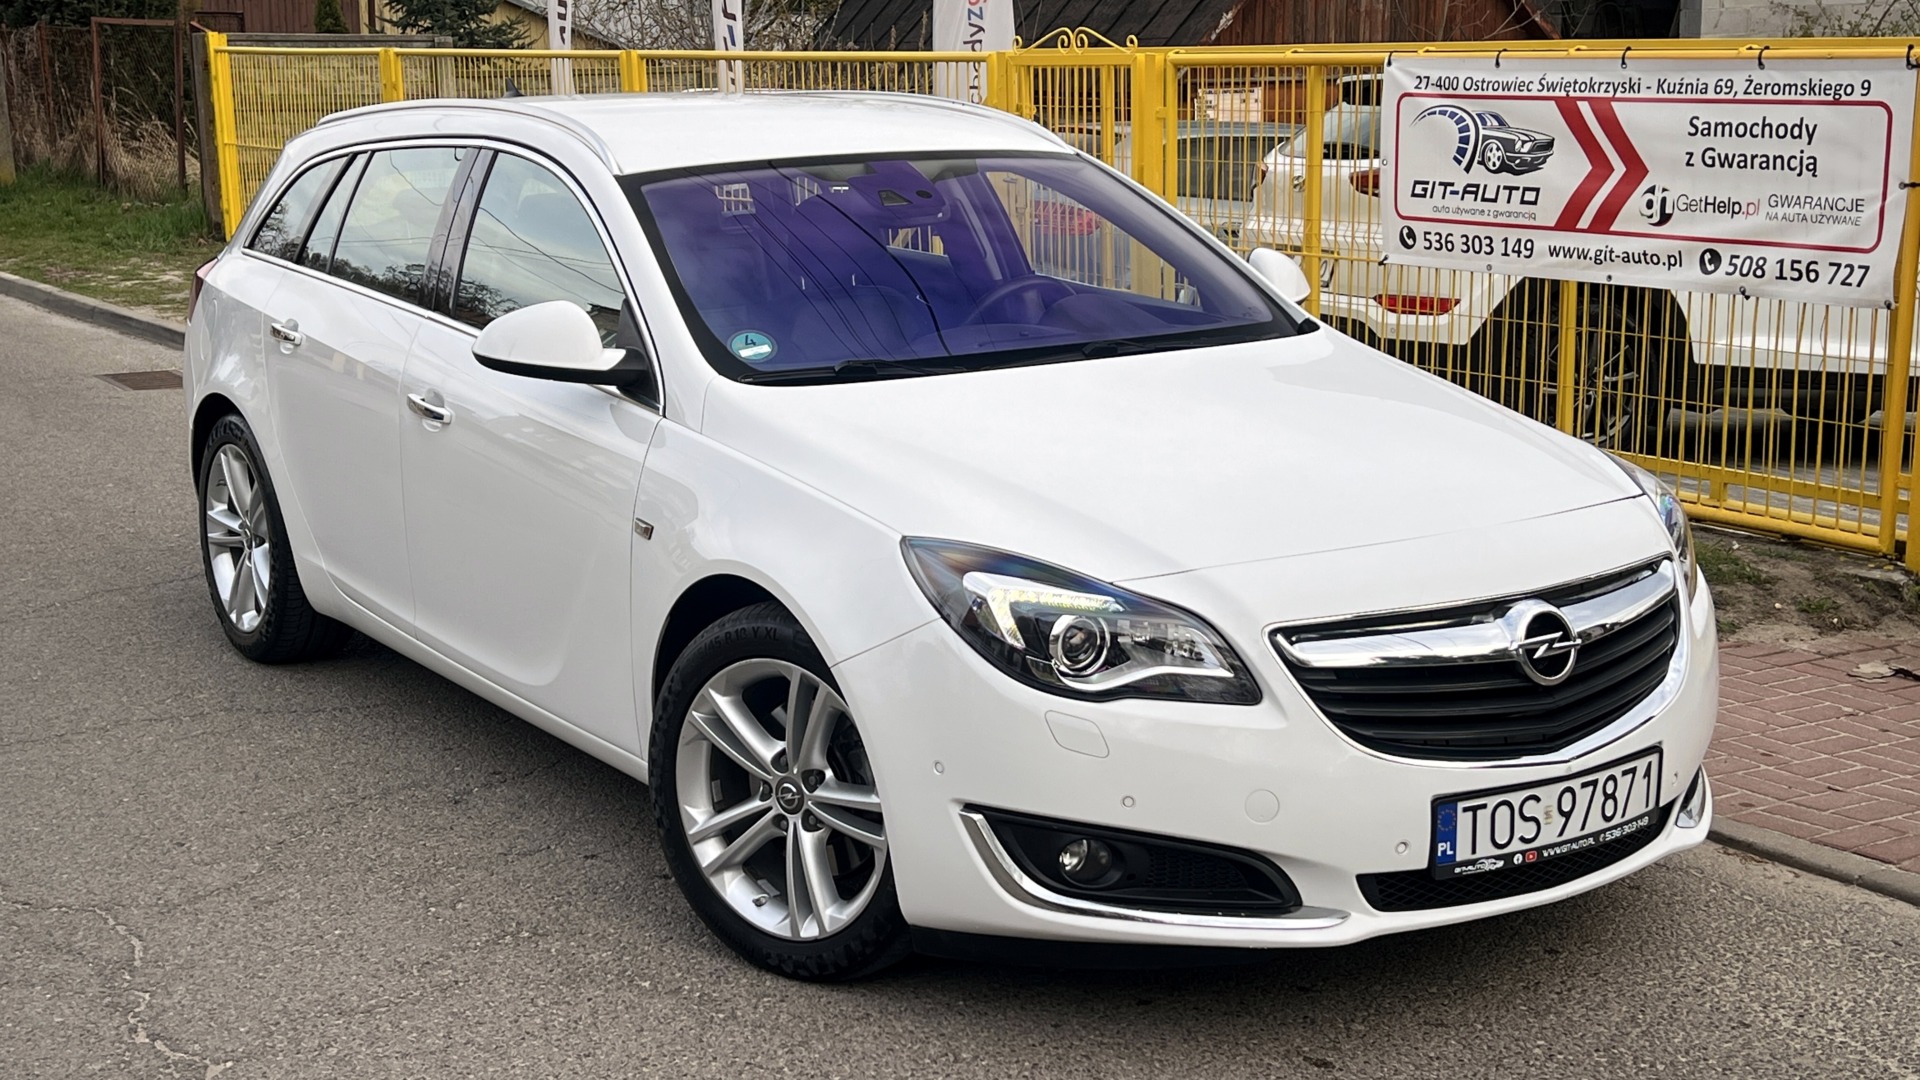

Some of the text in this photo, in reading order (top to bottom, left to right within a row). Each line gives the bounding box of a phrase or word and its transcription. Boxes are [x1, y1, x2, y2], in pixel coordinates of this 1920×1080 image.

[1413, 75, 1459, 91] 27-400
[1463, 77, 1534, 93] Ostrowiec
[1537, 73, 1641, 97] Świętokrzyski
[1656, 77, 1708, 95] Kuźnia
[1714, 78, 1738, 98] 69,
[1743, 74, 1855, 100] Żeromskiego
[1860, 79, 1872, 97] 9
[1687, 115, 1818, 146] Samochody
[1685, 147, 1818, 178] z Gwarancją
[1410, 180, 1541, 206] GIT-AUTO
[1768, 194, 1865, 213] GWARANCJE
[1432, 205, 1450, 213] auta
[1676, 194, 1760, 219] GetHelp.pl
[1765, 211, 1779, 221] NA
[1780, 213, 1808, 223] AUTA
[1423, 231, 1534, 259] 536 303 149
[1548, 244, 1683, 271] www.git-auto.pl
[1725, 254, 1871, 288] 508 156 727
[744, 334, 757, 346] 4
[1462, 760, 1653, 855] TOS 97871
[1437, 842, 1454, 857] PL
